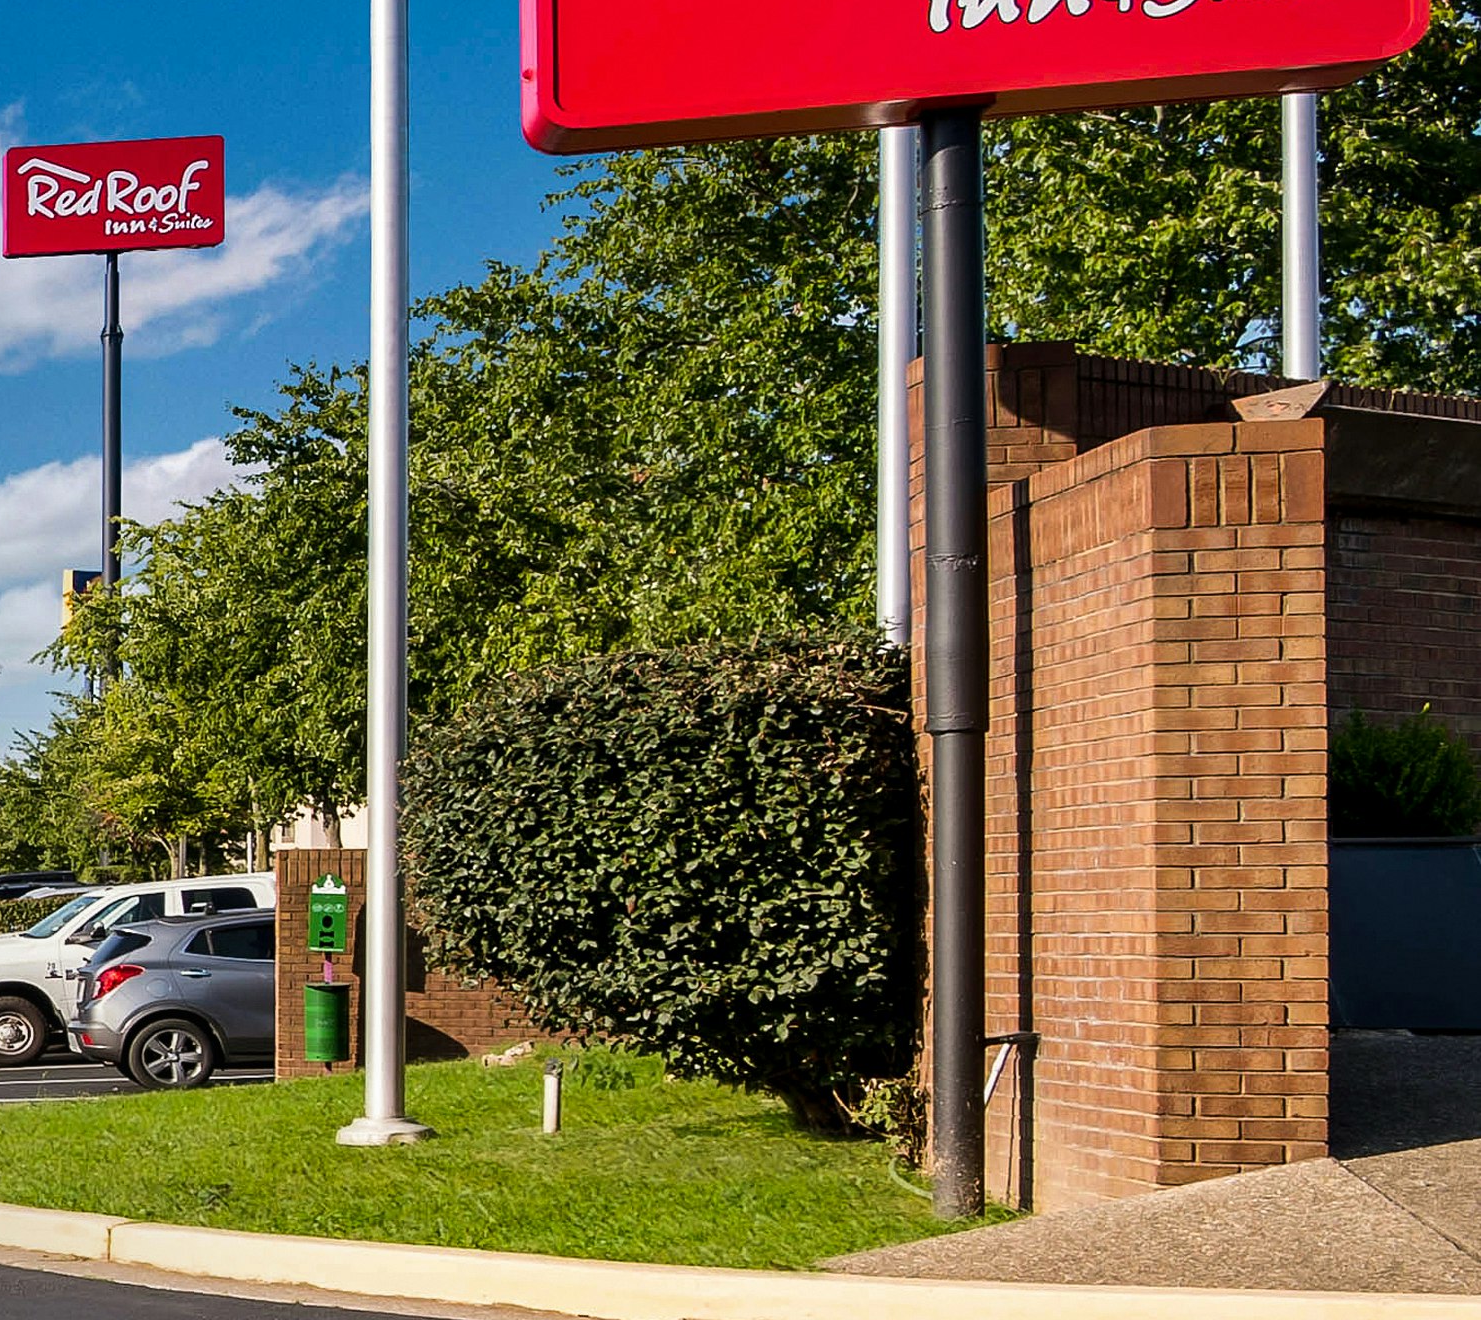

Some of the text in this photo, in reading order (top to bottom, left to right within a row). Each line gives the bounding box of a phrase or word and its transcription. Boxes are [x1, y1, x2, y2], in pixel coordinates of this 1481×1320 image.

[26, 159, 209, 219] Red Roof
[104, 211, 214, 236] Inn & Suites
